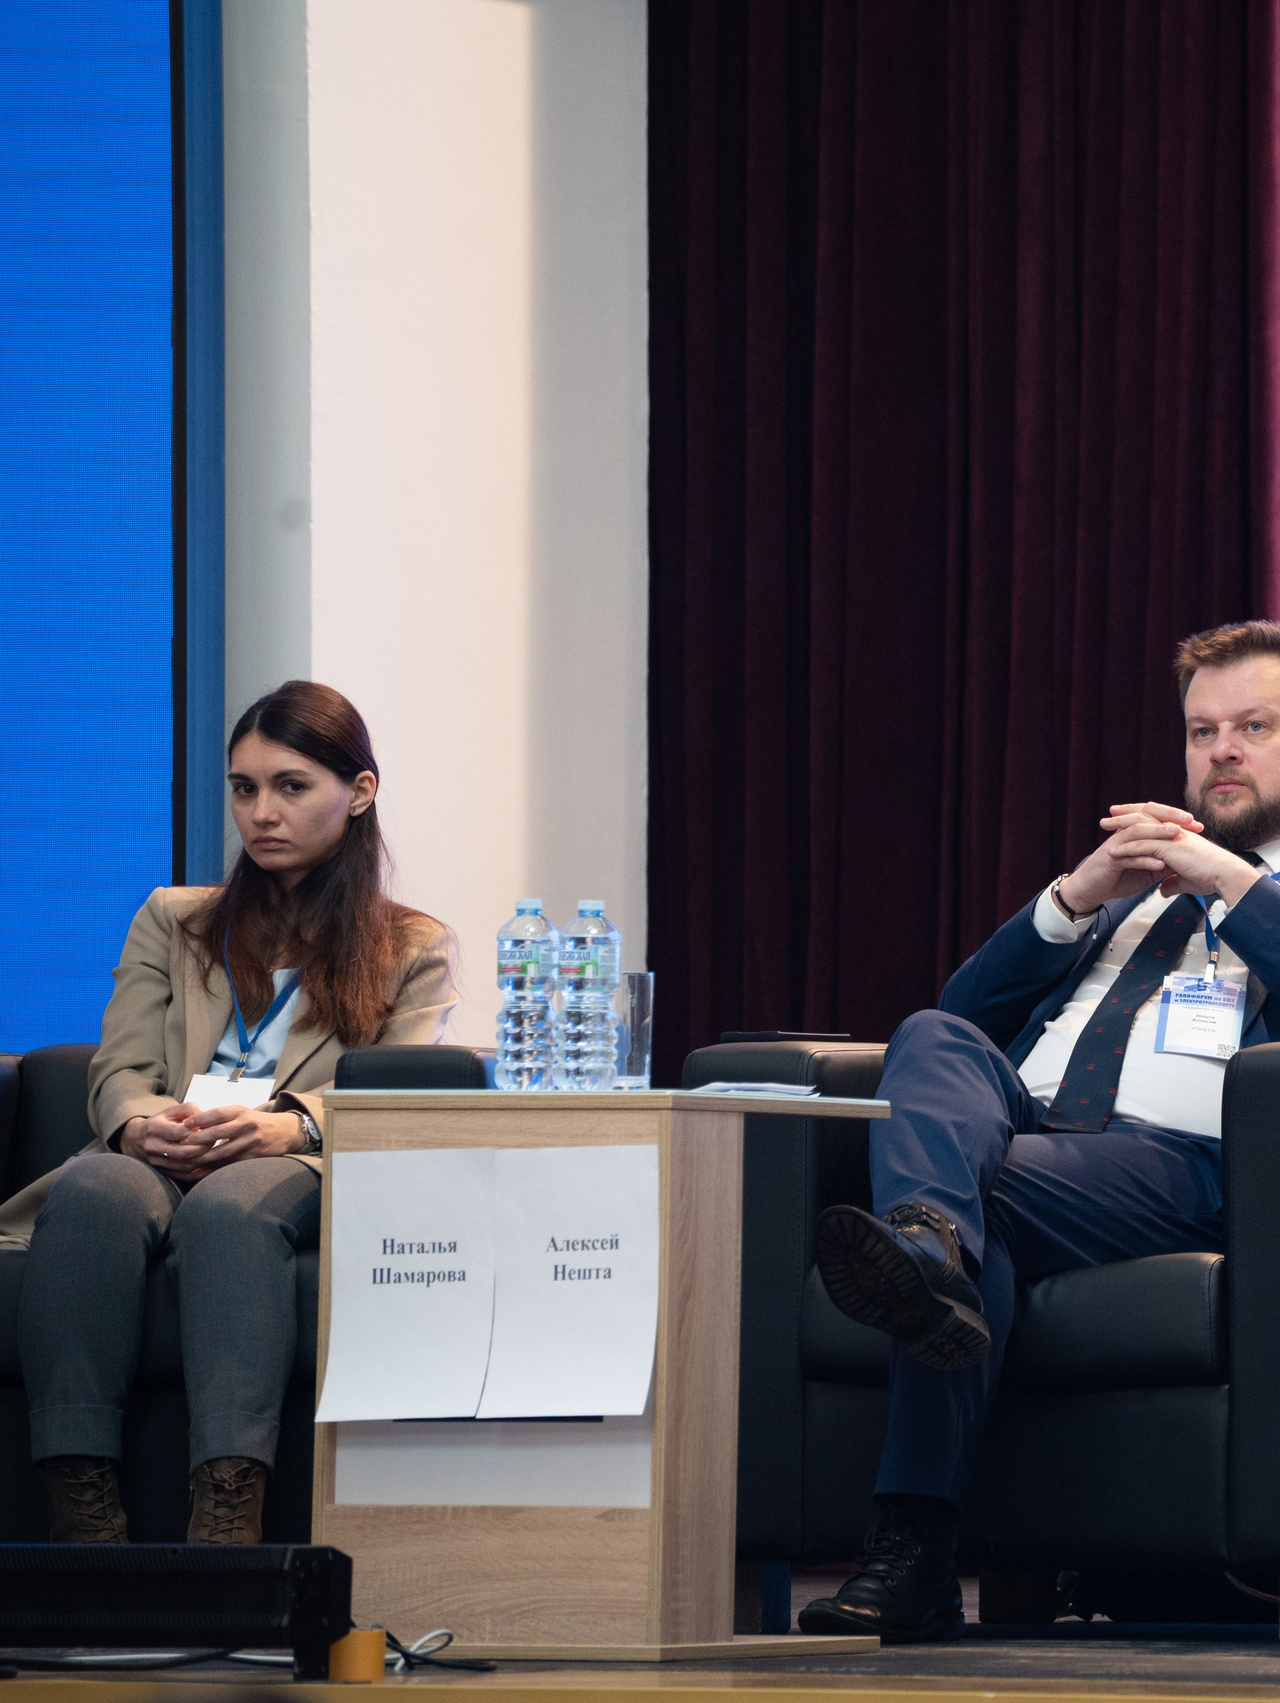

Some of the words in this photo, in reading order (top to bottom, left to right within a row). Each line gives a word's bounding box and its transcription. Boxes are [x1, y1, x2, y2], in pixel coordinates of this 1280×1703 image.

[383, 1239, 457, 1255] Наталья
[547, 1234, 619, 1252] Алексей
[373, 1268, 465, 1287] Шамарова
[554, 1265, 611, 1281] Нешта
